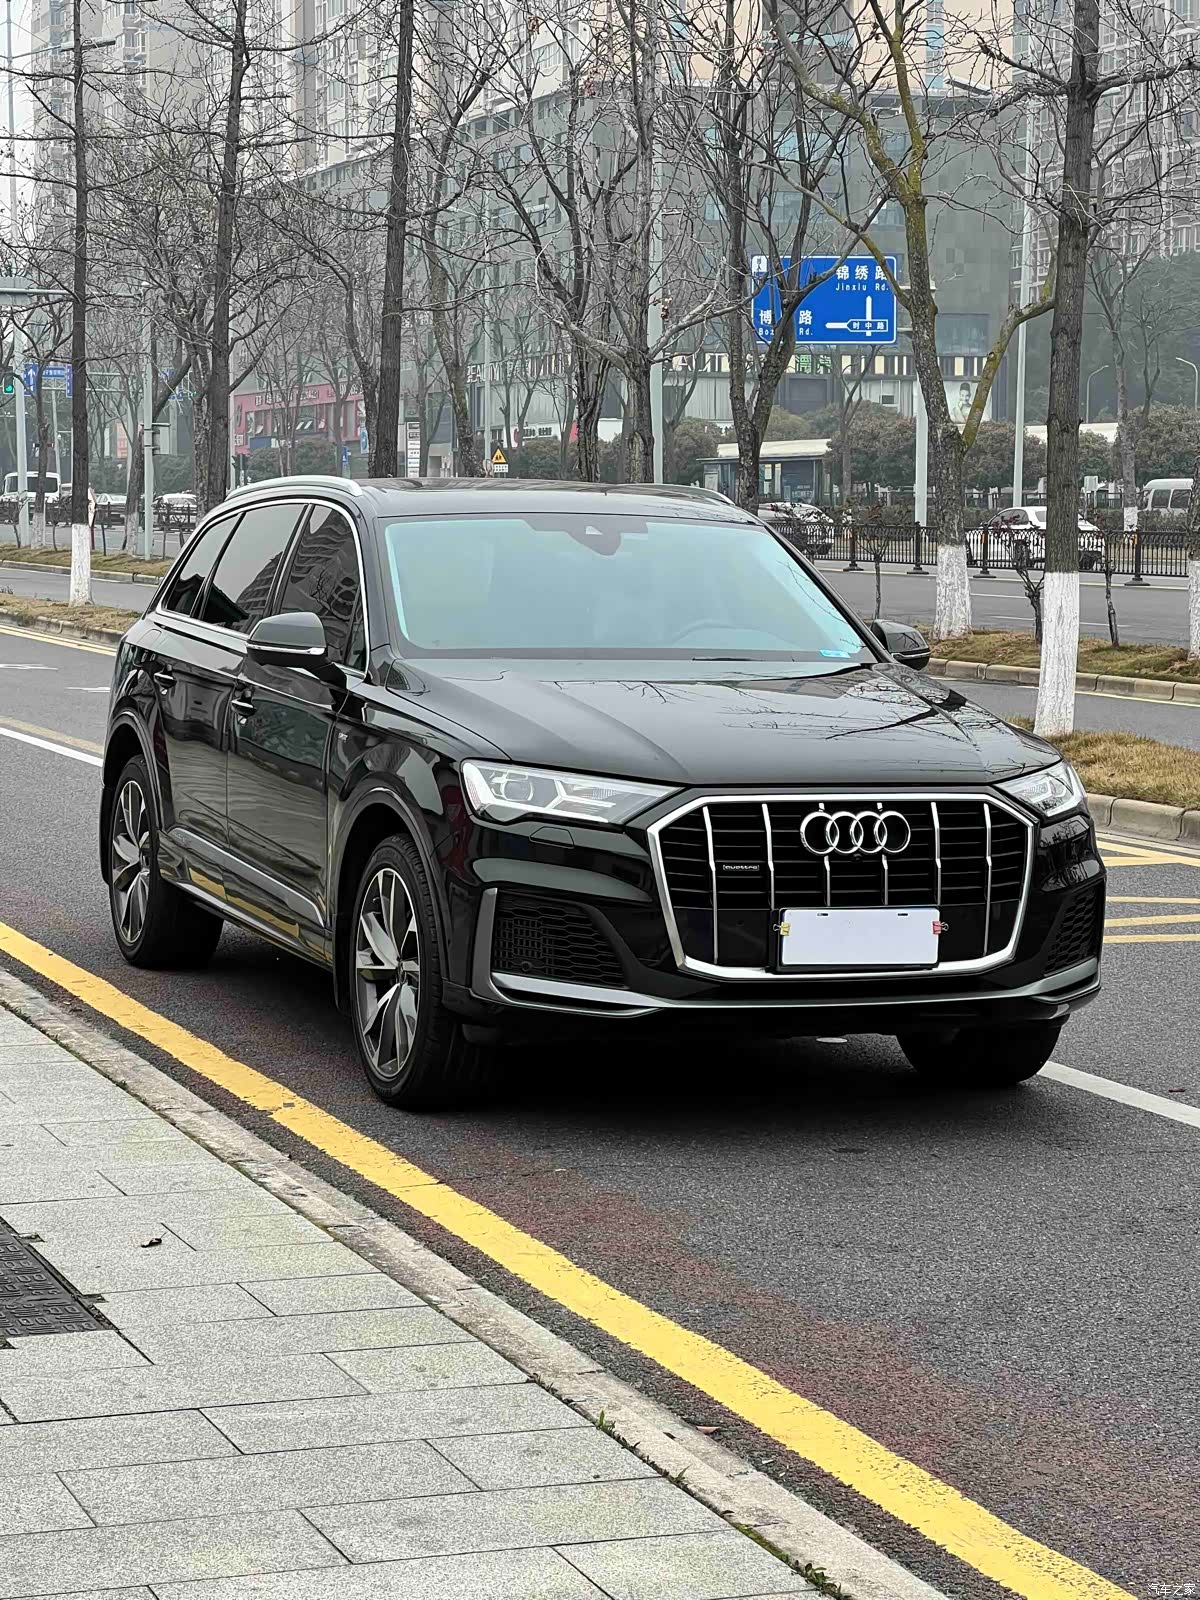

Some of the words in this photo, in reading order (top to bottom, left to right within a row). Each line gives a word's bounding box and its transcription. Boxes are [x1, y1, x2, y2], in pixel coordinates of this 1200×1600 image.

[835, 282, 867, 291] Jinxiu
[875, 282, 889, 291] Rd.
[759, 309, 813, 326] 博路
[799, 327, 813, 336] Rd.
